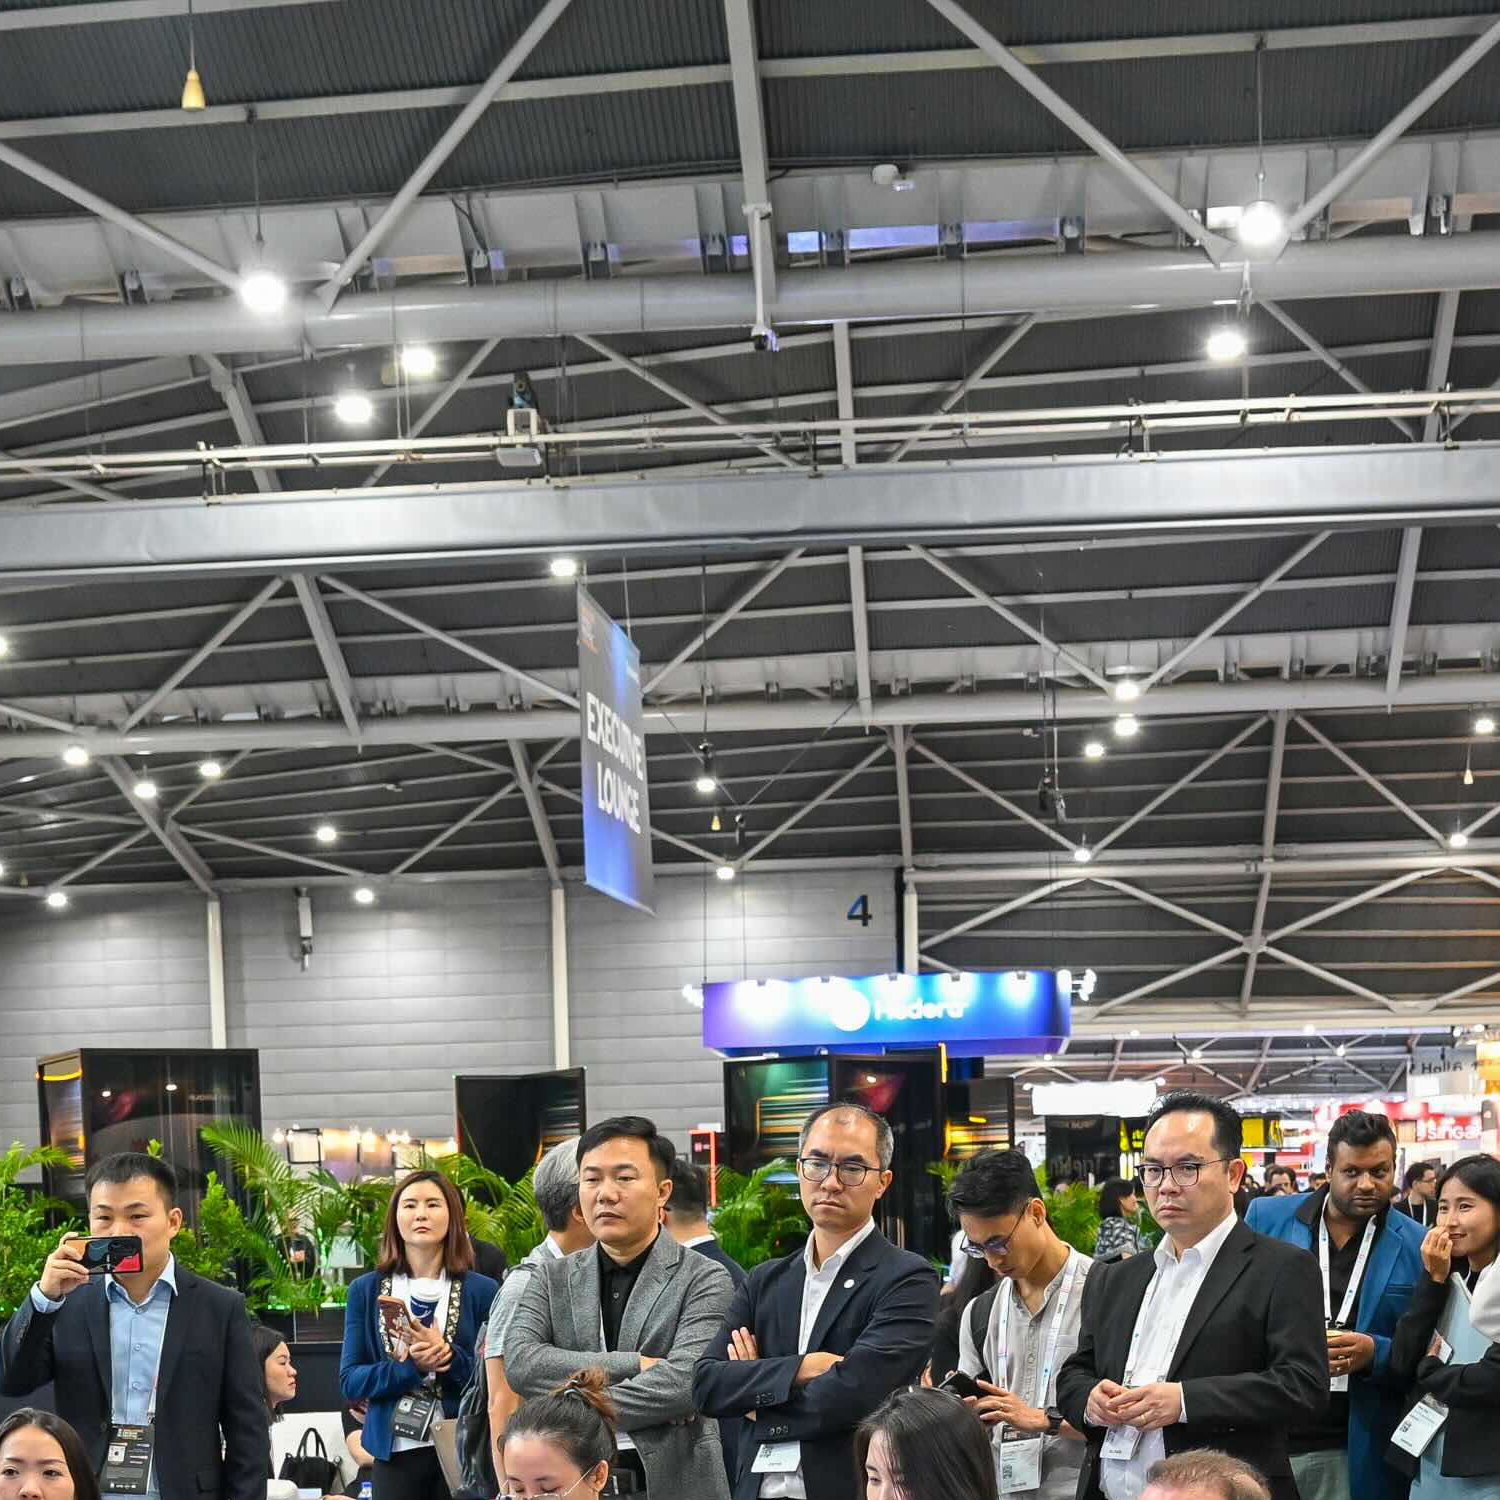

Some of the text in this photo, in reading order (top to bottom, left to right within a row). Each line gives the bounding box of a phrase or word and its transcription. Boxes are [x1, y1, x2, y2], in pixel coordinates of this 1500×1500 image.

[586, 692, 643, 781] EXECUTIVE
[597, 761, 641, 834] LOUNGE
[847, 895, 872, 927] 4
